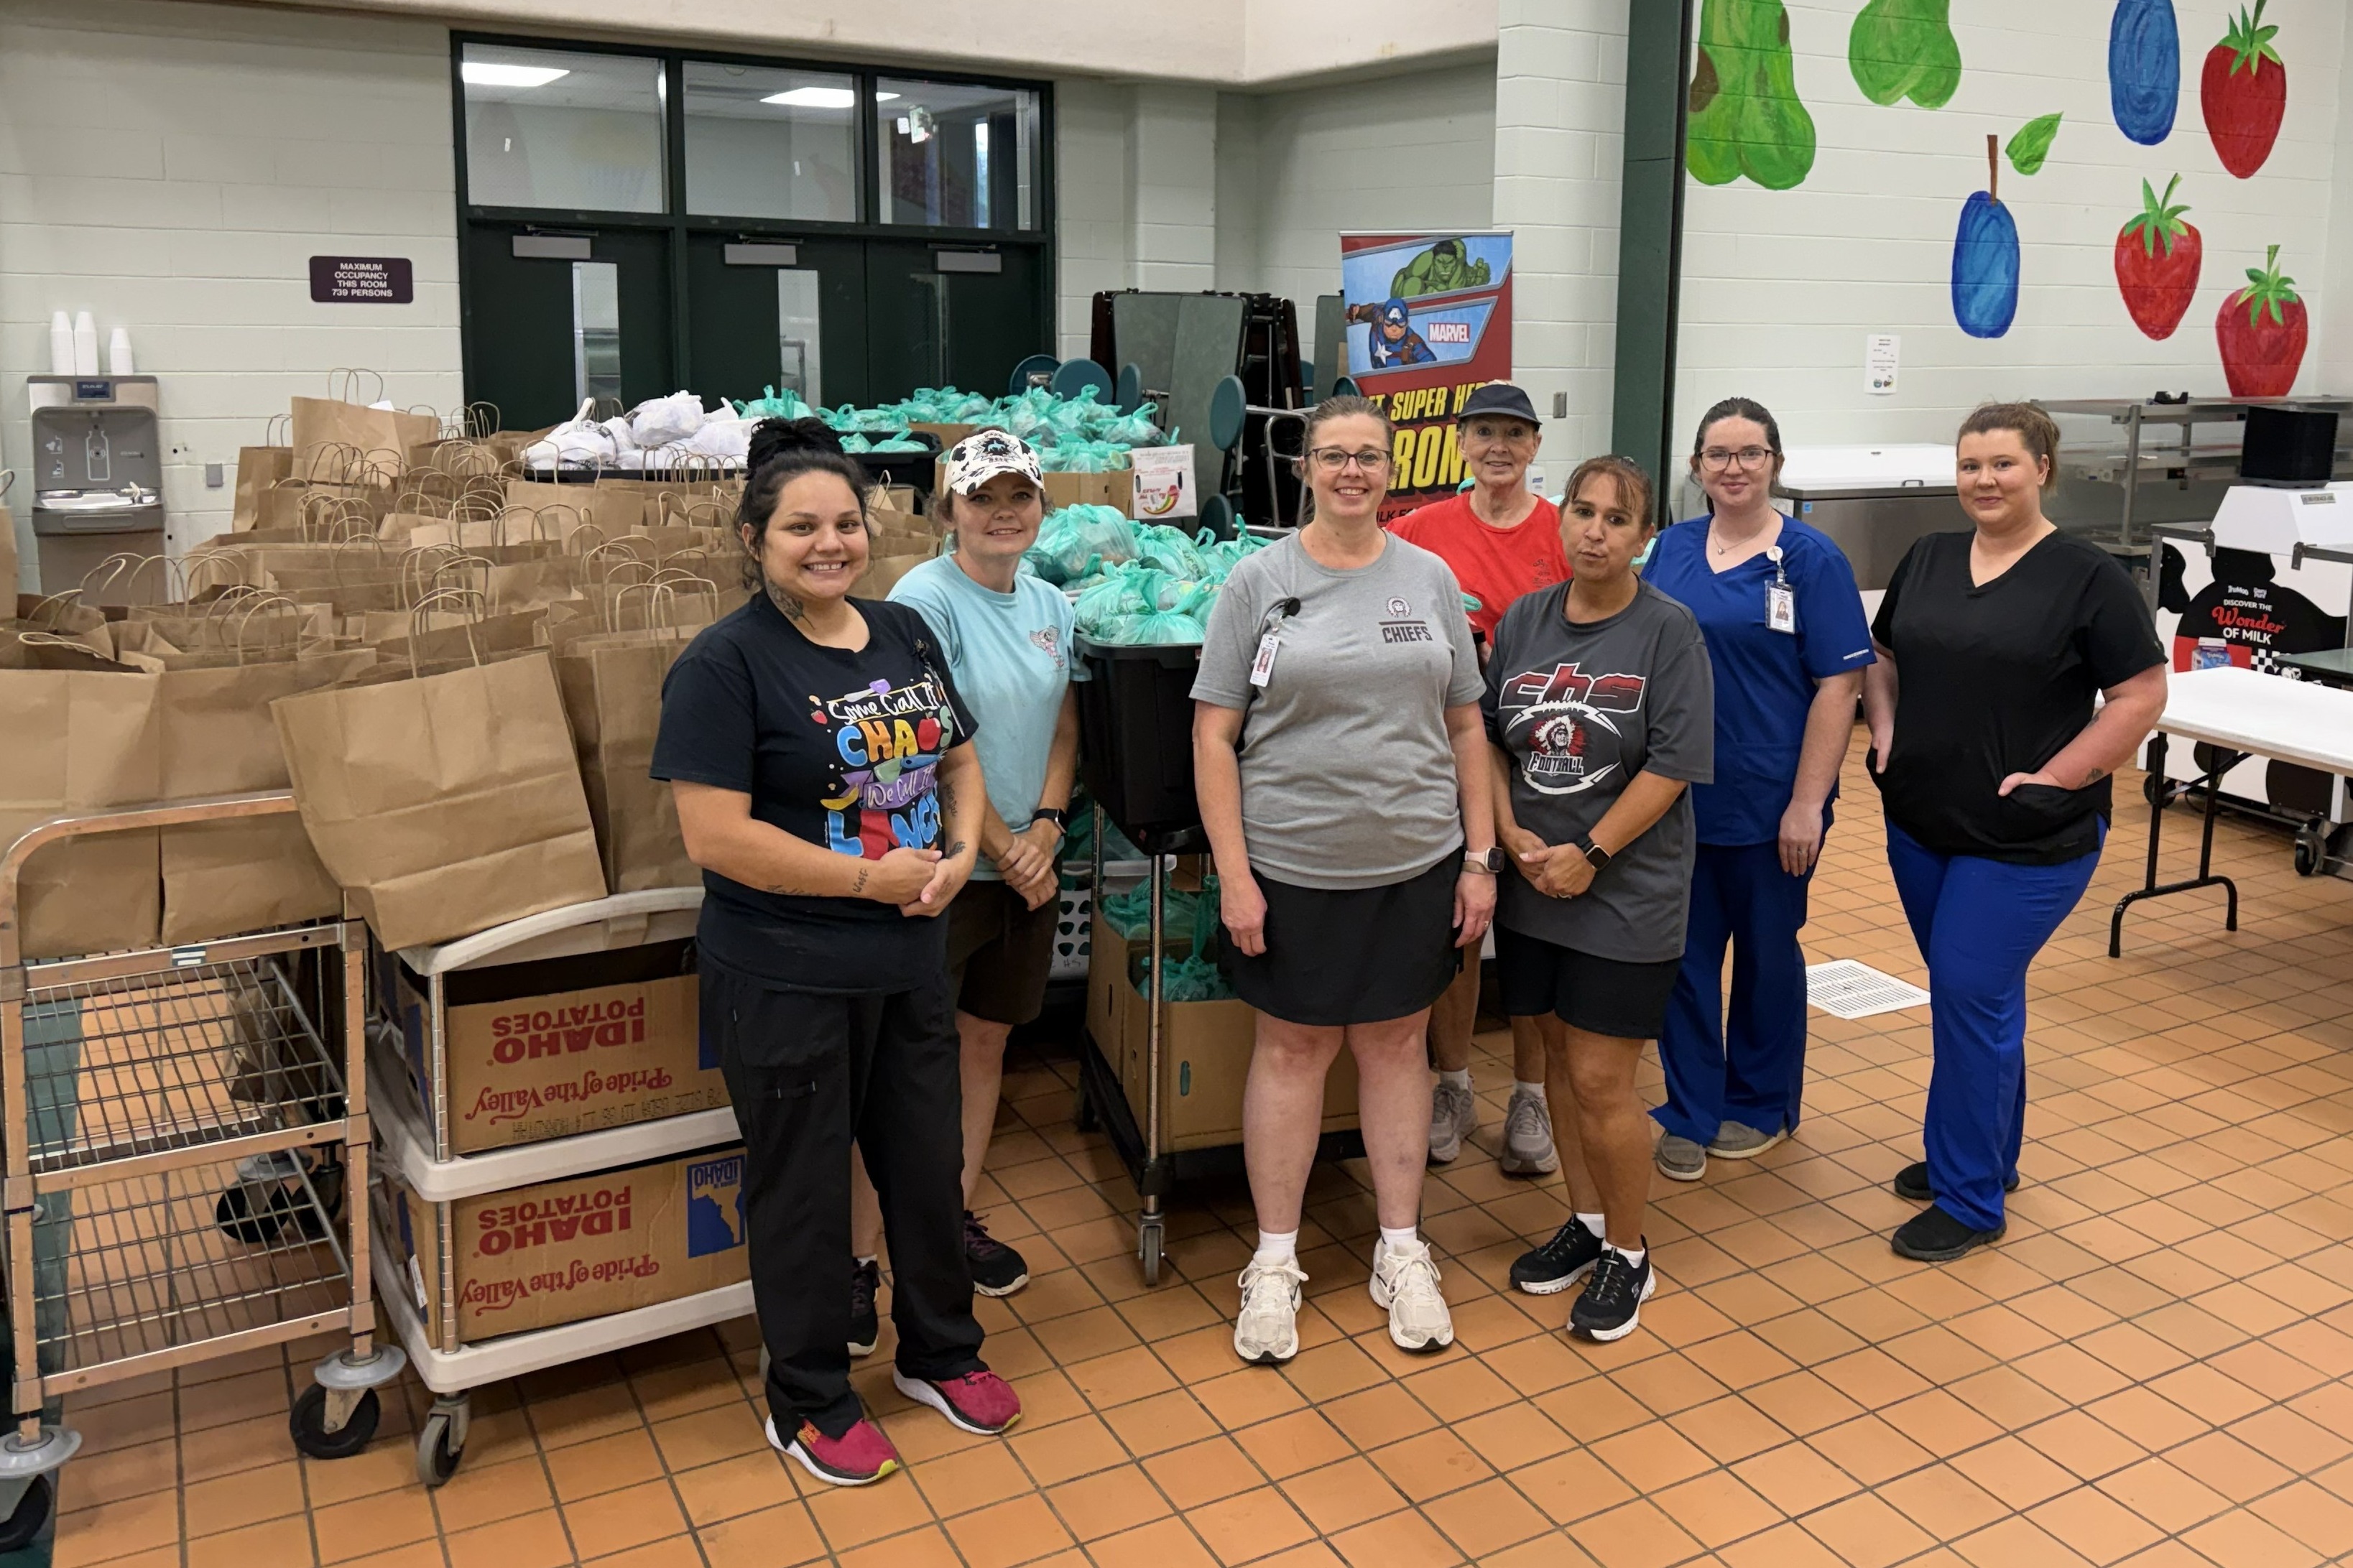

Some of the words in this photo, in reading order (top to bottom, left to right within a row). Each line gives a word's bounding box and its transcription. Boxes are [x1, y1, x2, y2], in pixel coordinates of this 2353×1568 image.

[1428, 323, 1470, 343] MARVEL
[1390, 386, 1448, 422] SUPER
[1387, 424, 1474, 491] RON
[1376, 510, 1396, 523] ILK
[2223, 598, 2257, 609] DISCOVER
[2258, 602, 2273, 612] THE
[2211, 606, 2285, 634] Wonder
[1382, 626, 1433, 644] CHIEFS
[2222, 627, 2240, 639] OF
[2242, 629, 2272, 646] MILK
[880, 686, 923, 716] Call
[1527, 751, 1584, 776] FOOTBALL
[866, 784, 894, 809] We
[897, 776, 918, 803] Call
[491, 996, 645, 1038] POTATOES
[492, 1019, 645, 1064] IDAHO
[544, 1080, 579, 1103] the
[579, 1070, 604, 1101] of
[606, 1067, 672, 1094] Pride
[465, 1086, 545, 1125] Valley
[694, 1161, 739, 1187] IDAHO
[478, 1185, 631, 1230] POTATOES
[479, 1206, 631, 1256] IDAHO
[530, 1270, 565, 1293] the
[565, 1259, 589, 1291] of
[593, 1253, 660, 1281] Pride
[458, 1277, 531, 1317] Valley
